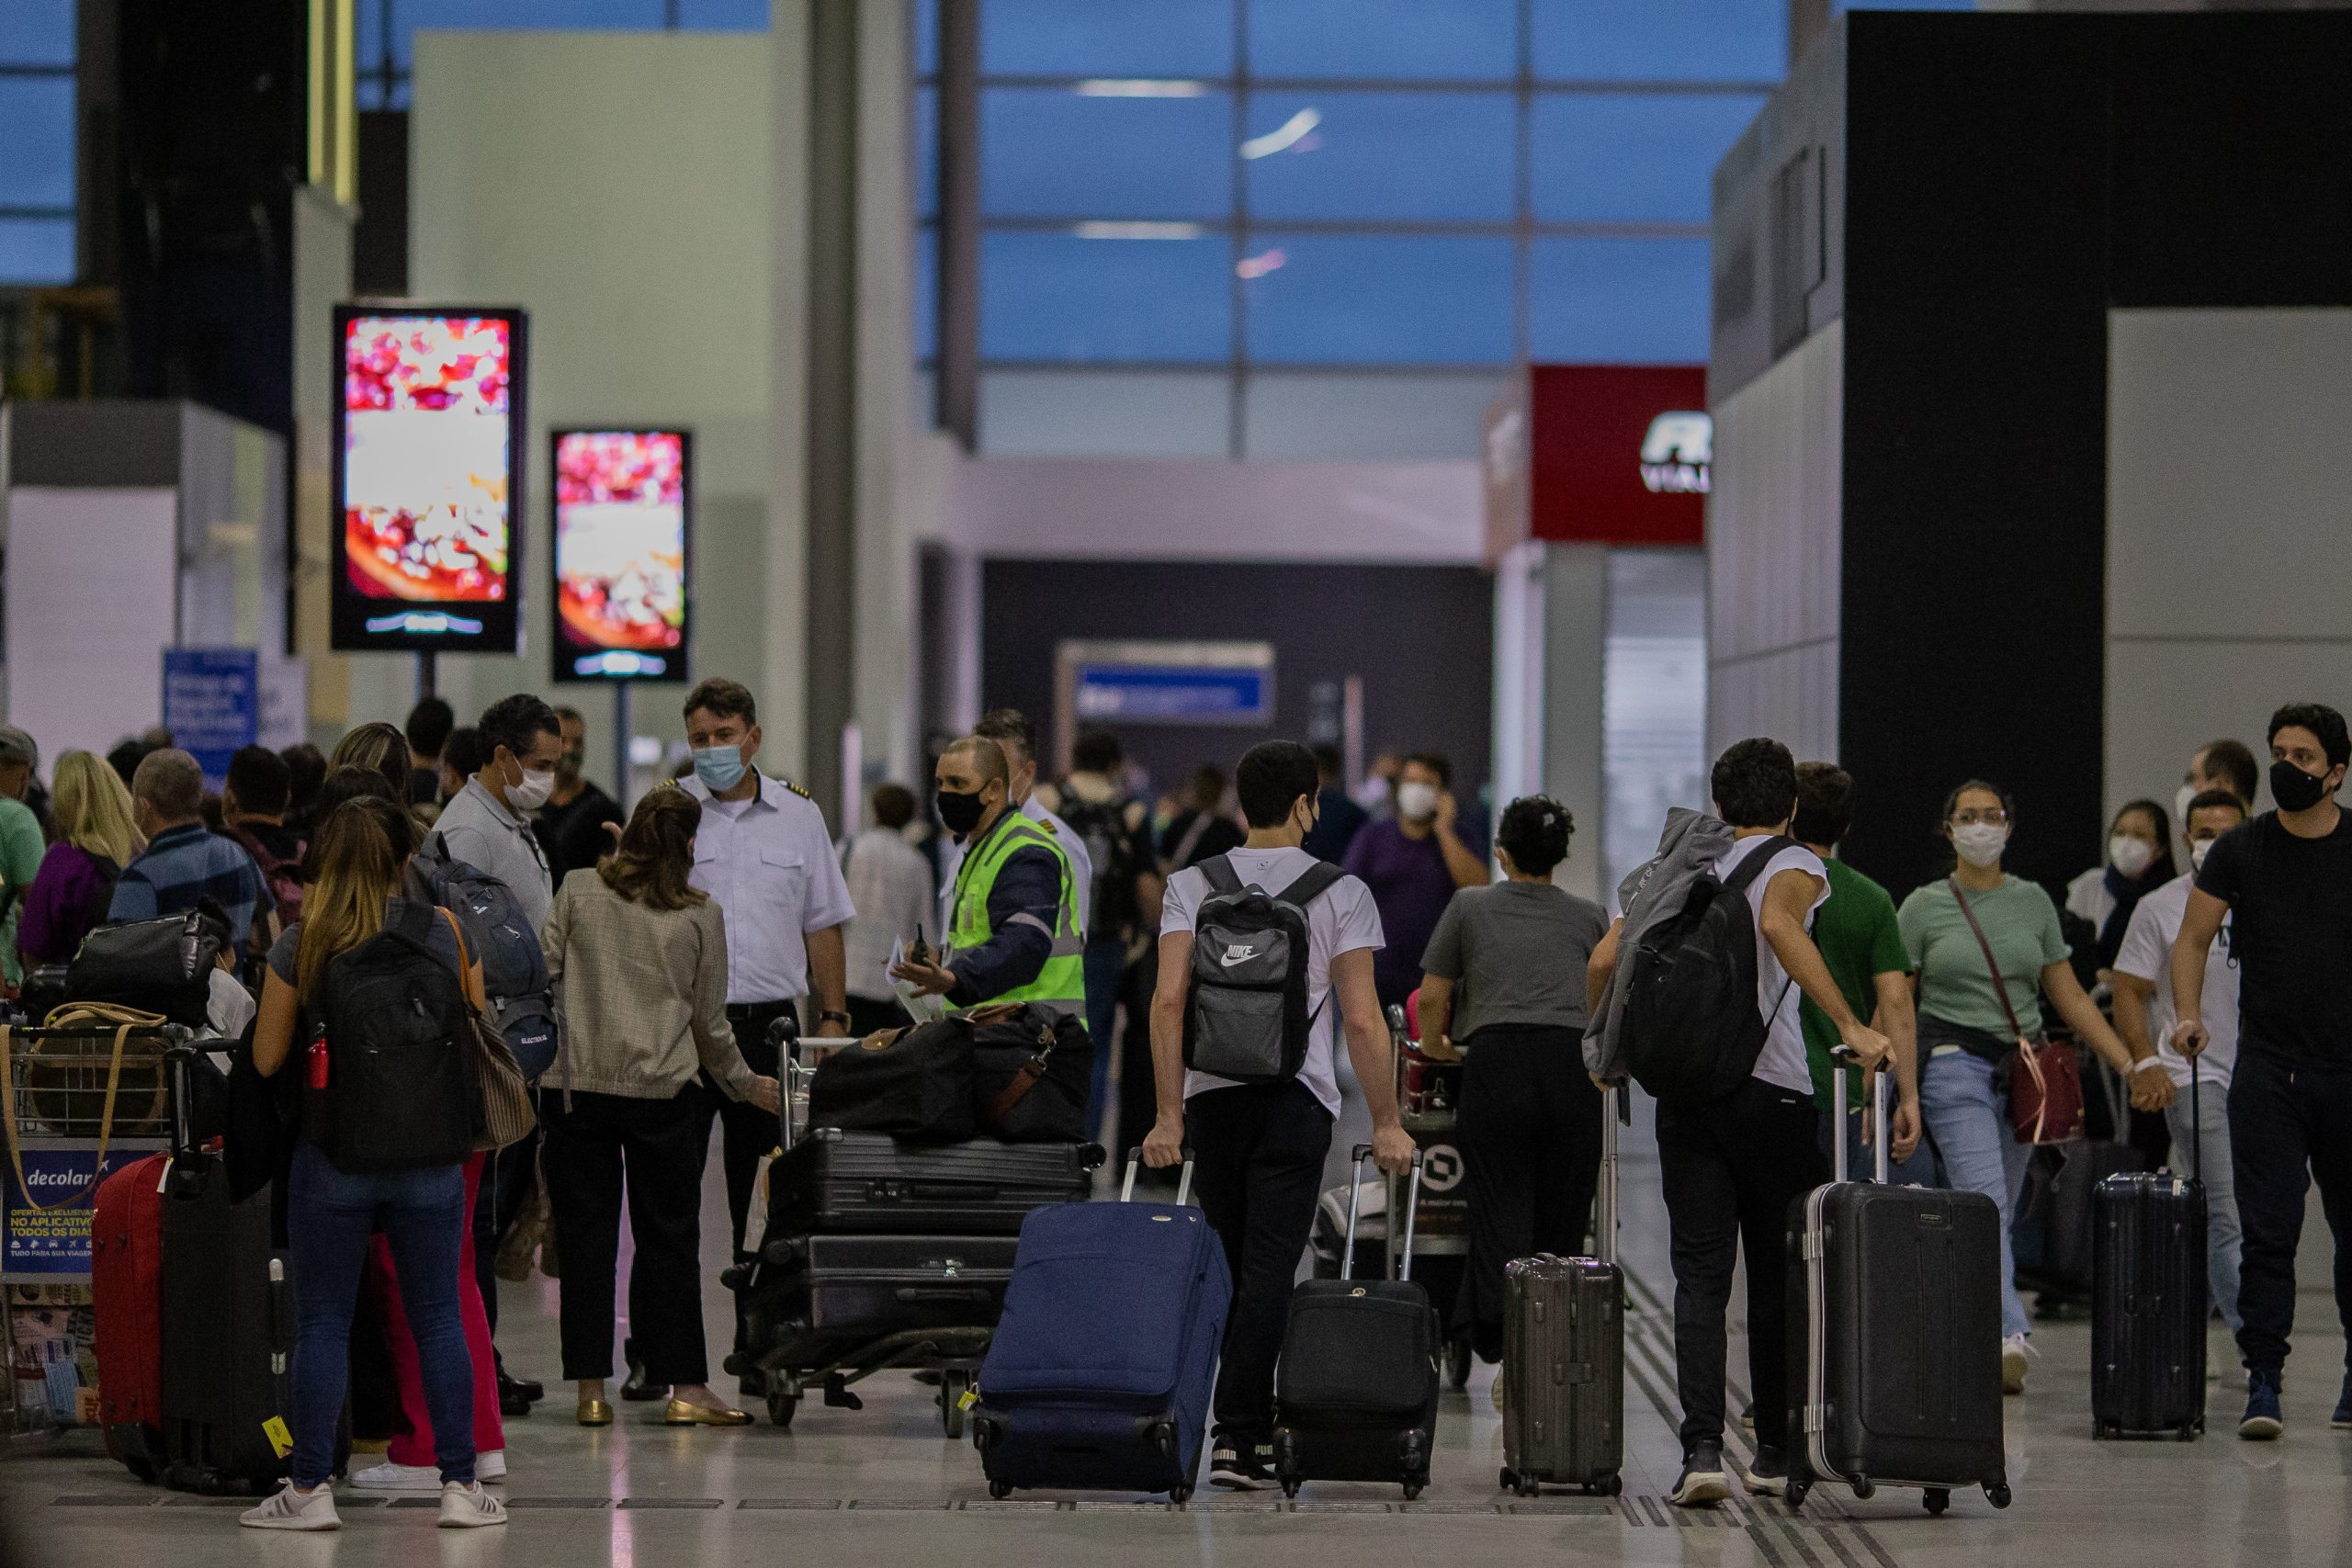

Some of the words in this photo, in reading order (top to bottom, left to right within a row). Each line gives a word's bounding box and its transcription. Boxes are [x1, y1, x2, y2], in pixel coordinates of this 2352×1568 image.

[1227, 944, 1253, 958] NIKE
[28, 1168, 93, 1186] decolar
[10, 1217, 28, 1227] NO
[12, 1227, 50, 1236] TODOS
[52, 1227, 67, 1236] OS
